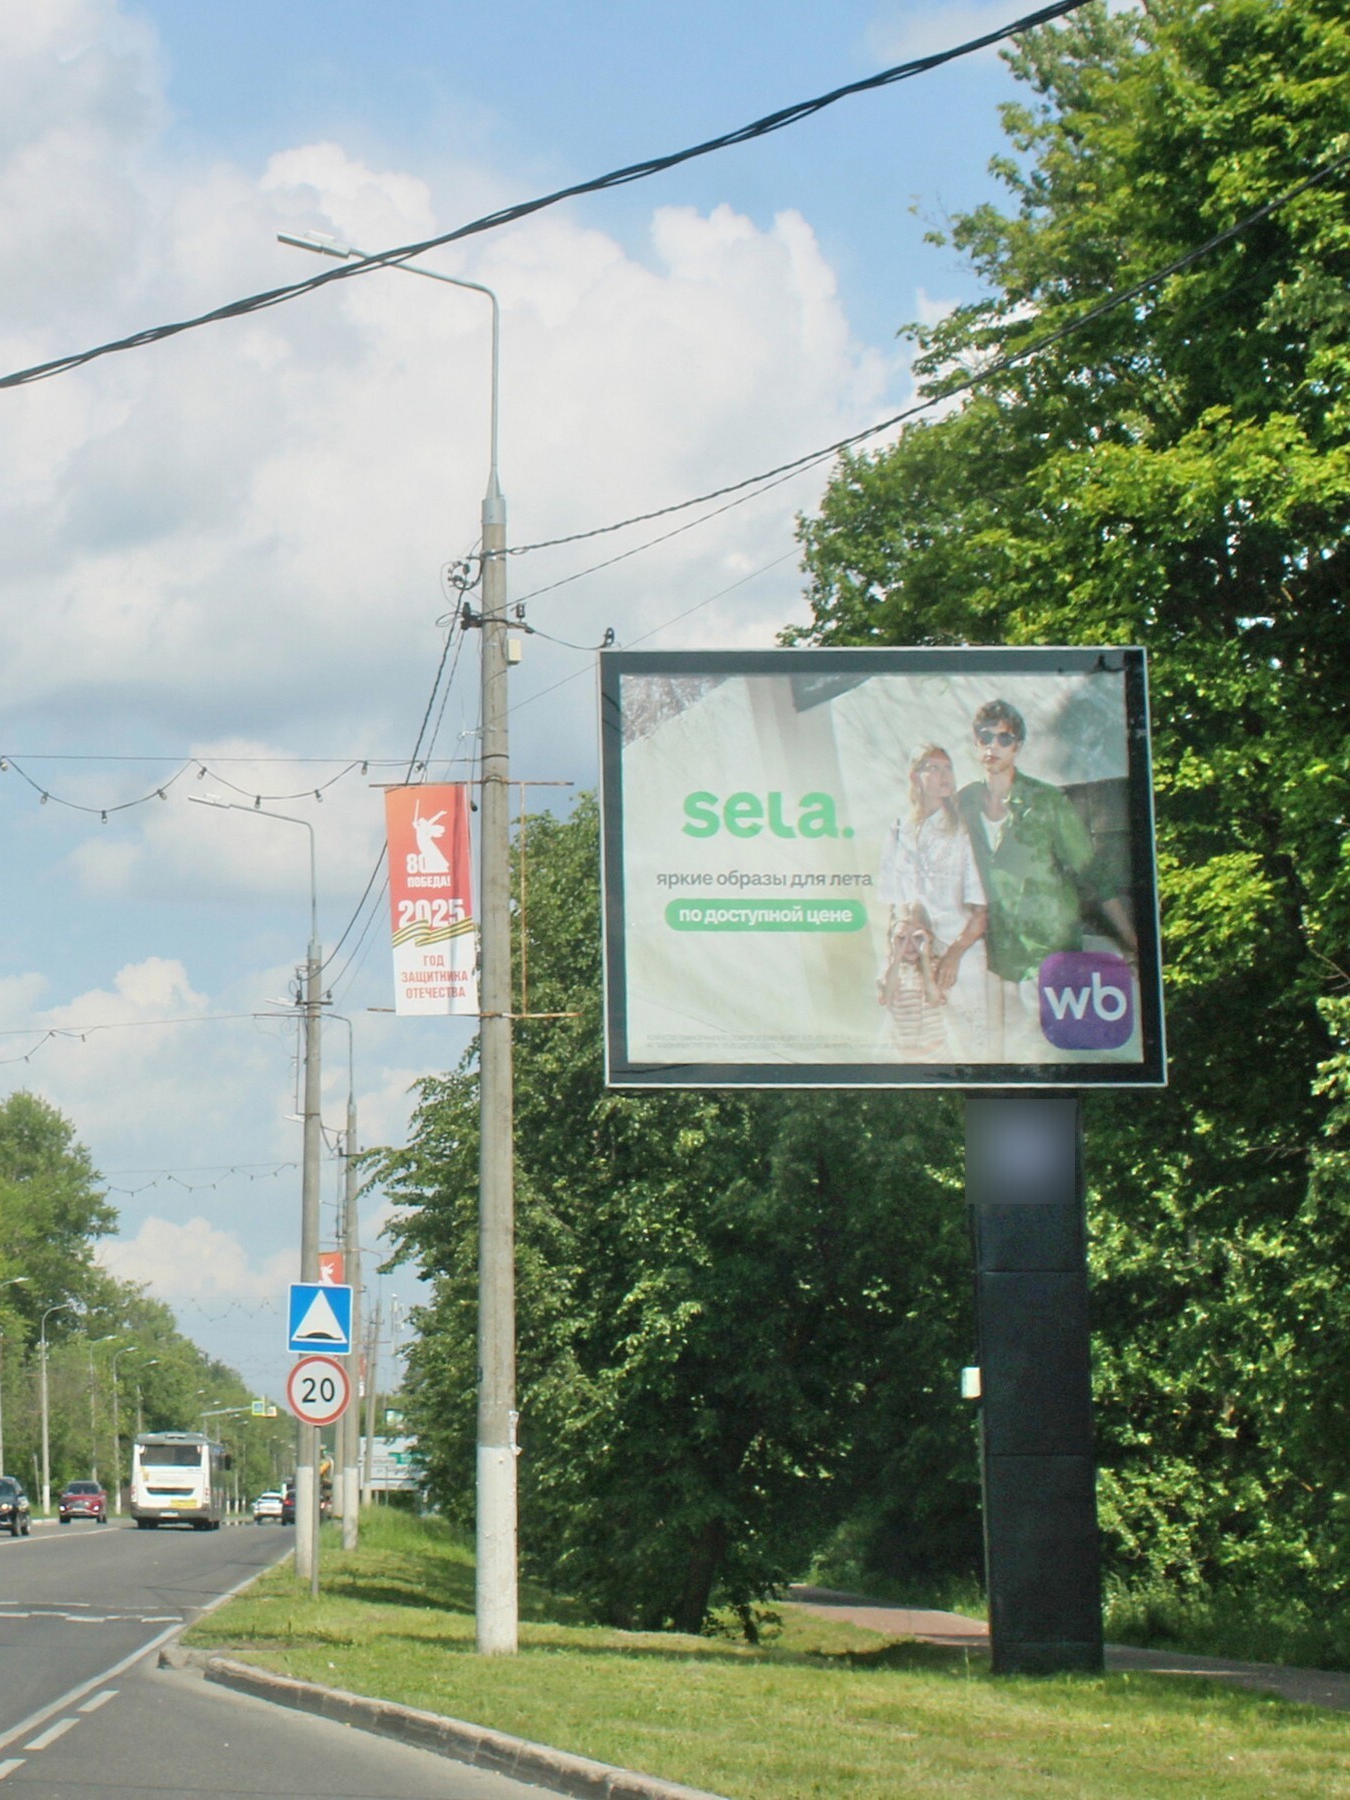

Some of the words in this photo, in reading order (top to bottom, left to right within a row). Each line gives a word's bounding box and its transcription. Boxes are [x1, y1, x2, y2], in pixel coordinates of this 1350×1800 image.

[682, 791, 855, 839] sela.
[407, 876, 451, 888] ПОБЕДА!
[656, 873, 713, 889] яркие
[716, 870, 787, 889] образы
[790, 874, 826, 889] для
[829, 874, 873, 886] лета
[397, 899, 466, 928] 2025
[679, 909, 702, 922] по
[704, 905, 802, 925] доступной
[806, 909, 853, 924] цене
[423, 954, 445, 967] ГОД
[401, 970, 468, 983] ЗАЩИТНИКА
[405, 986, 466, 999] ОТЕЧЕСТВА
[1043, 972, 1127, 1021] wb
[302, 1377, 335, 1403] 20
